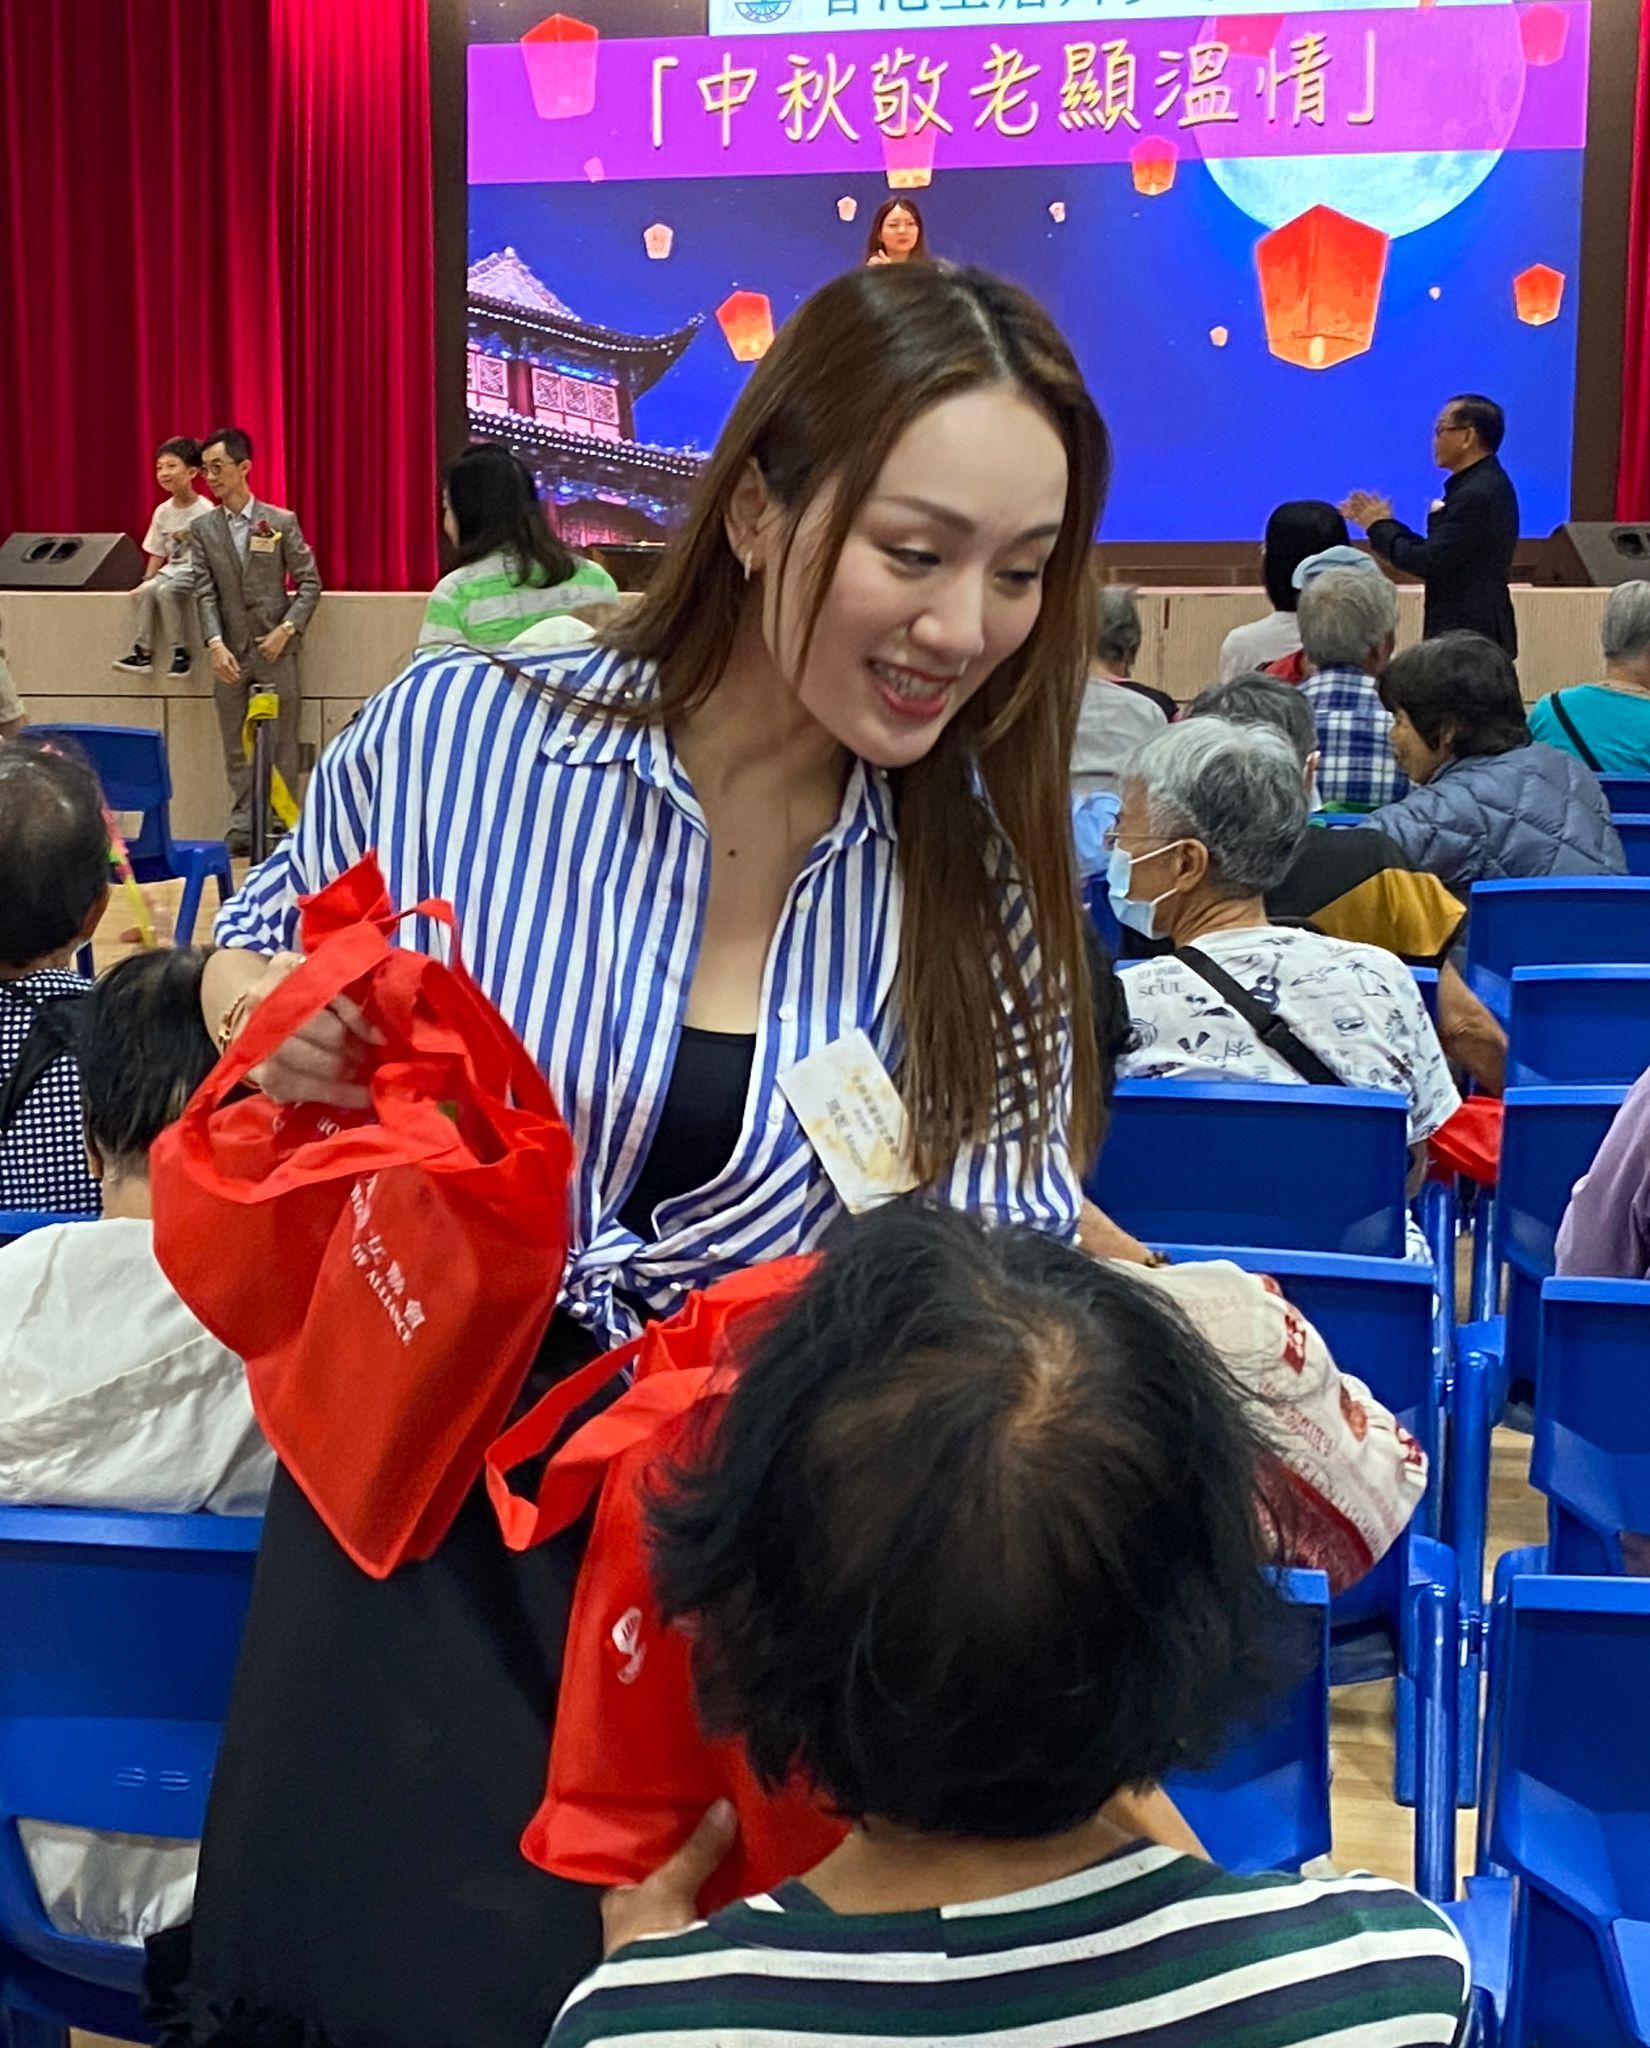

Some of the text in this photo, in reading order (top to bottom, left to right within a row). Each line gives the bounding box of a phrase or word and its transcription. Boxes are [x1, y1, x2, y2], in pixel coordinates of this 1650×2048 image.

[652, 28, 1376, 151] 「中秋敬老顯溫情」
